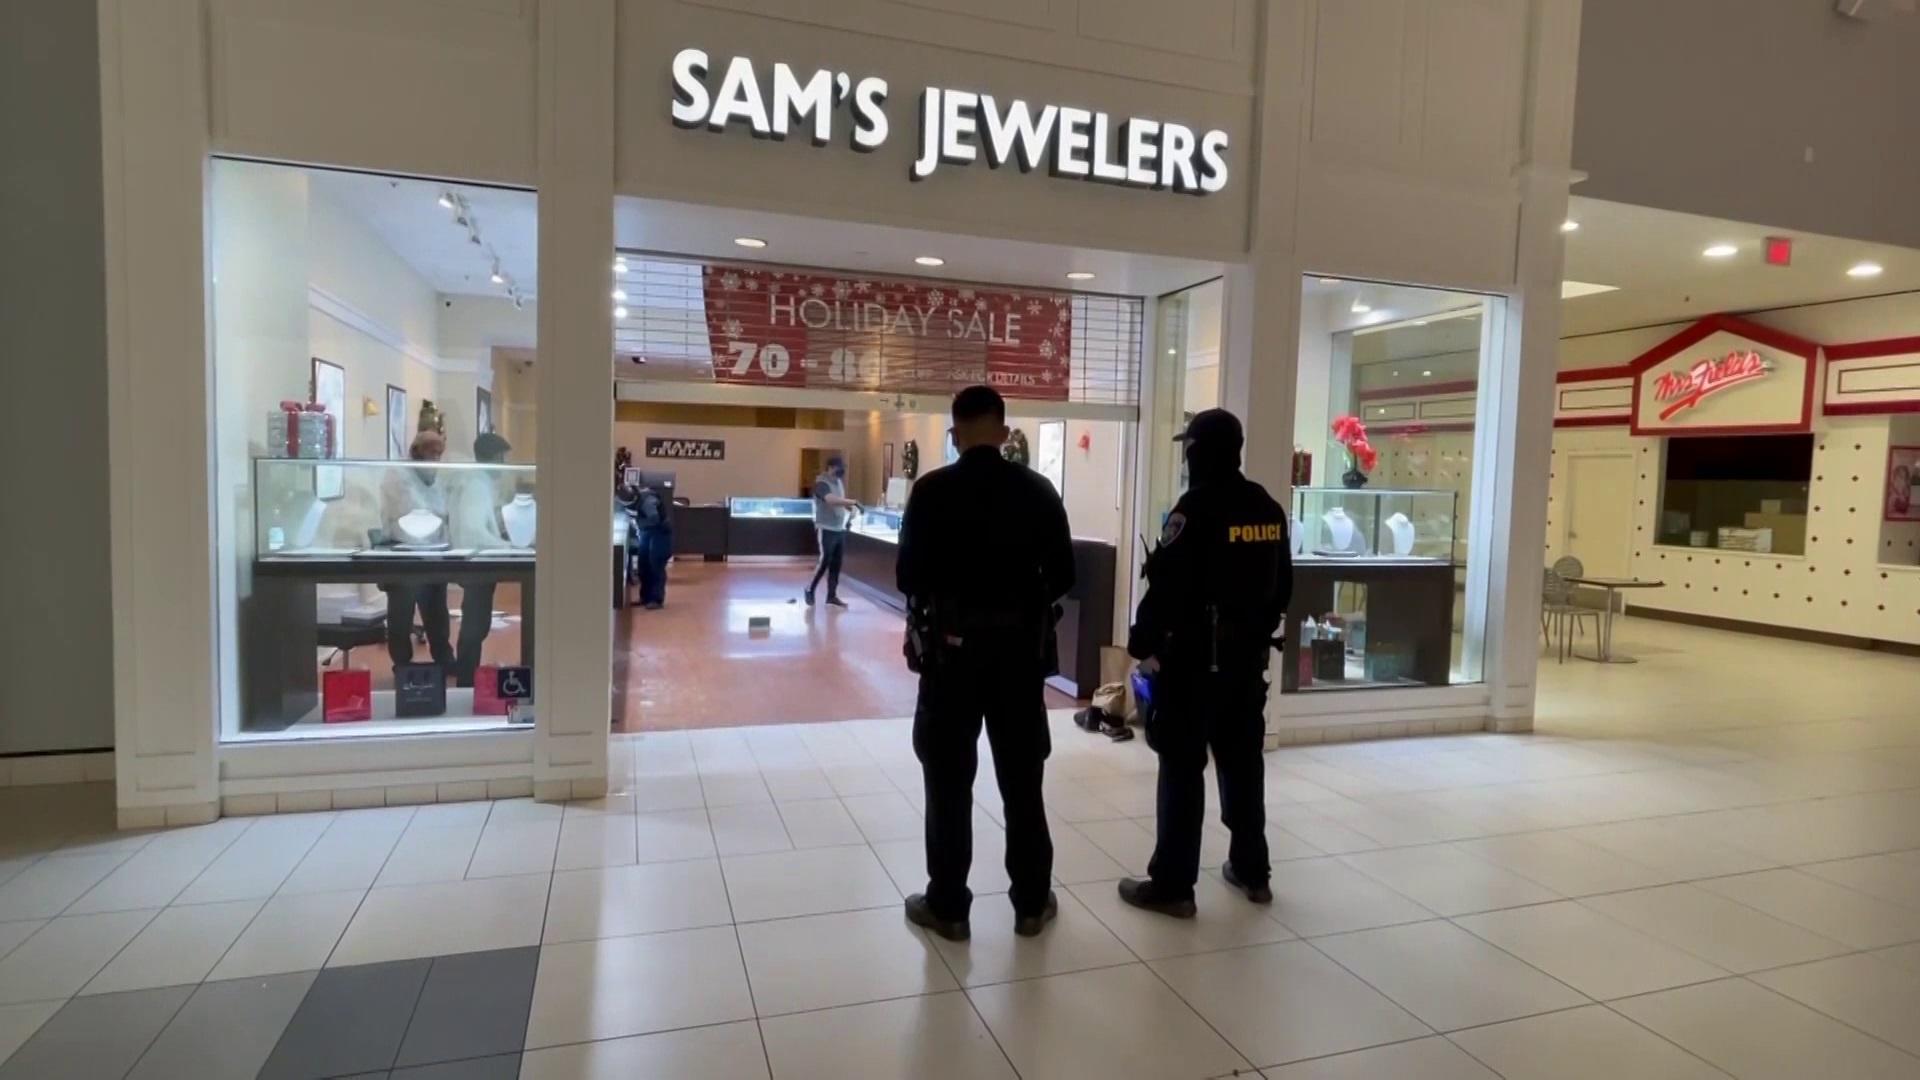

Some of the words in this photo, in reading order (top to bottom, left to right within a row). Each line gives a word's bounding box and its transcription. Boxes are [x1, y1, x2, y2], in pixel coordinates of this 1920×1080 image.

[671, 48, 889, 149] SAM'S
[913, 86, 1229, 193] JEWELERS
[770, 294, 936, 337] HOLIDAY
[946, 308, 1022, 345] SALE
[728, 341, 790, 378] 70
